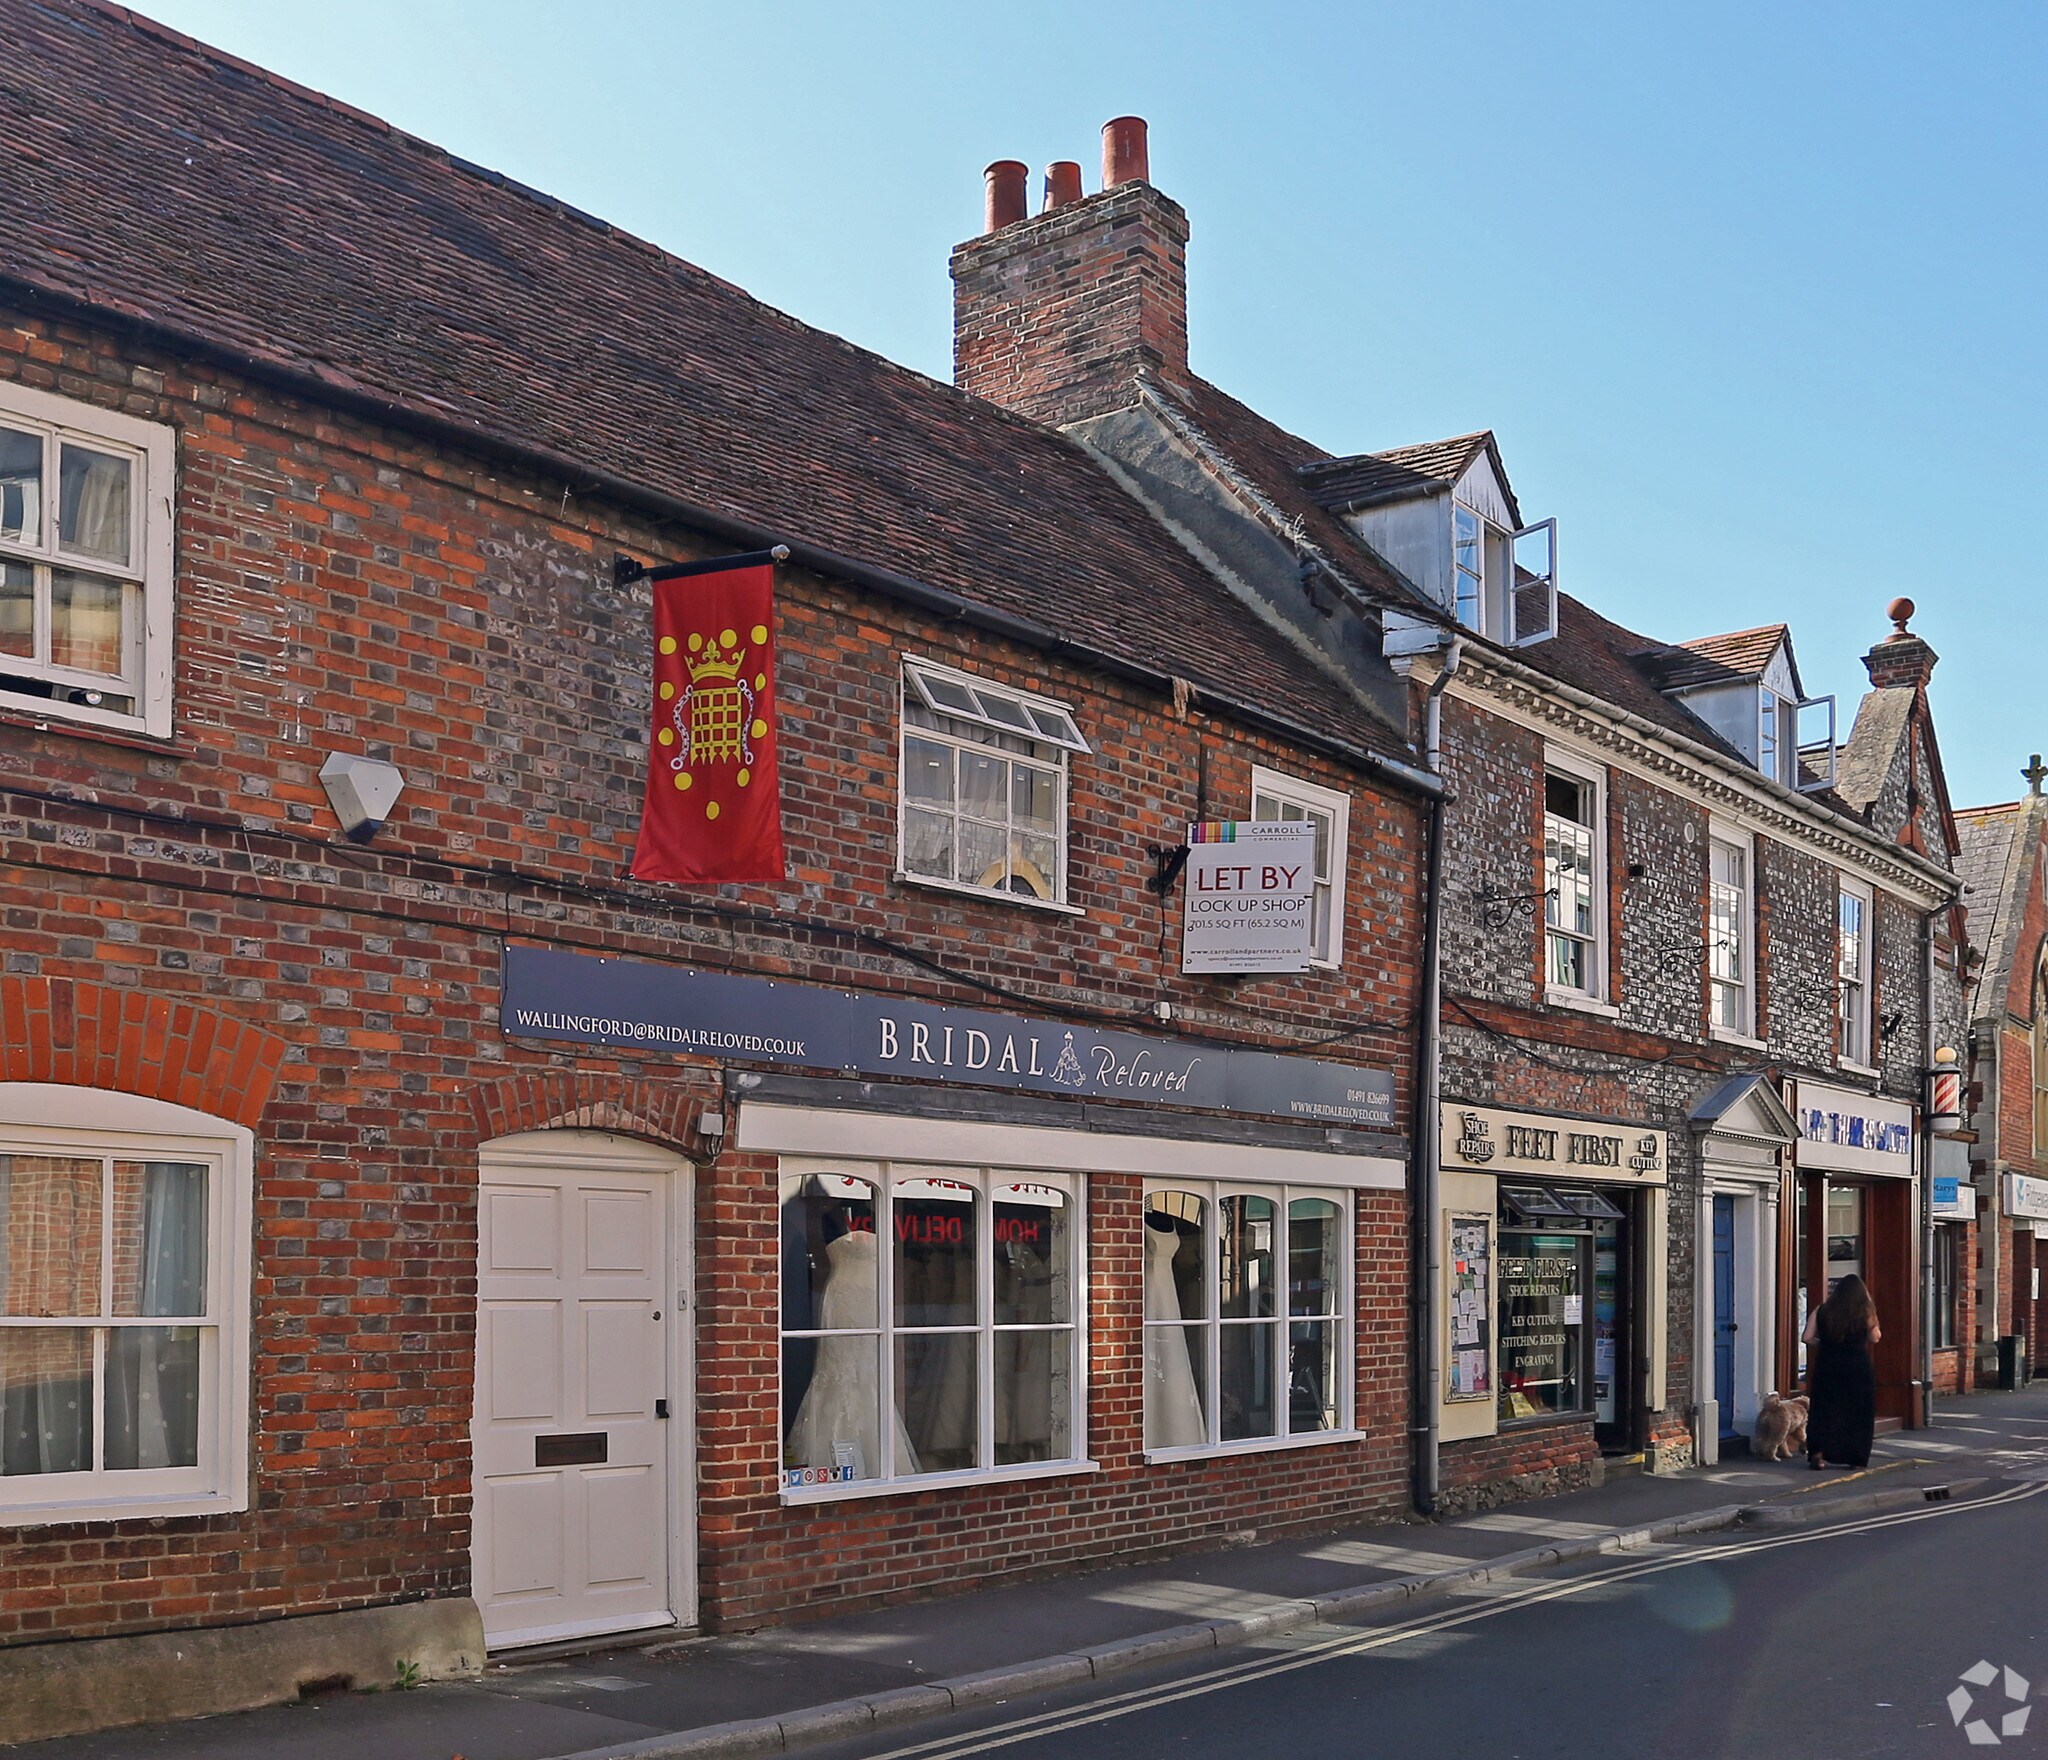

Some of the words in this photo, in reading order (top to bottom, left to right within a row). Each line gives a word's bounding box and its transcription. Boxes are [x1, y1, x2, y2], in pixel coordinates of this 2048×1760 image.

[1198, 867, 1252, 891] LET
[1261, 866, 1302, 890] BY
[1190, 900, 1232, 913] LOCK
[1237, 900, 1258, 912] UP
[1262, 899, 1306, 912] SHOP
[1215, 919, 1231, 929] SQ
[1233, 919, 1246, 928] FT
[1247, 919, 1271, 929] (65.2
[1272, 919, 1288, 929] SQ
[1290, 918, 1305, 929] M)
[517, 1009, 806, 1057] WALLINGFORD@BRIDALRELOVED.CO.UK
[879, 1017, 1044, 1076] BRIDAL
[1091, 1045, 1201, 1093] Reloved
[1290, 1101, 1390, 1122] WWW.BRIDALRELOVED.CO.UK
[1466, 1120, 1489, 1135] SHOE
[1460, 1139, 1496, 1156] REPAIRS
[1506, 1124, 1559, 1162] FEET
[1568, 1132, 1623, 1167] FIRST
[1640, 1139, 1655, 1152] KEY
[1632, 1156, 1662, 1170] CUTTING
[1498, 1257, 1530, 1278] FEET
[1534, 1257, 1570, 1278] FIRST
[1509, 1284, 1529, 1297] SHOE
[1529, 1284, 1560, 1296] REPAIRS
[1511, 1315, 1525, 1327] KEY
[1527, 1314, 1558, 1326] CUTTING
[1501, 1335, 1539, 1348] STITCHING
[1540, 1333, 1566, 1345] REPAIRS
[1515, 1354, 1554, 1368] ENGRAVING
